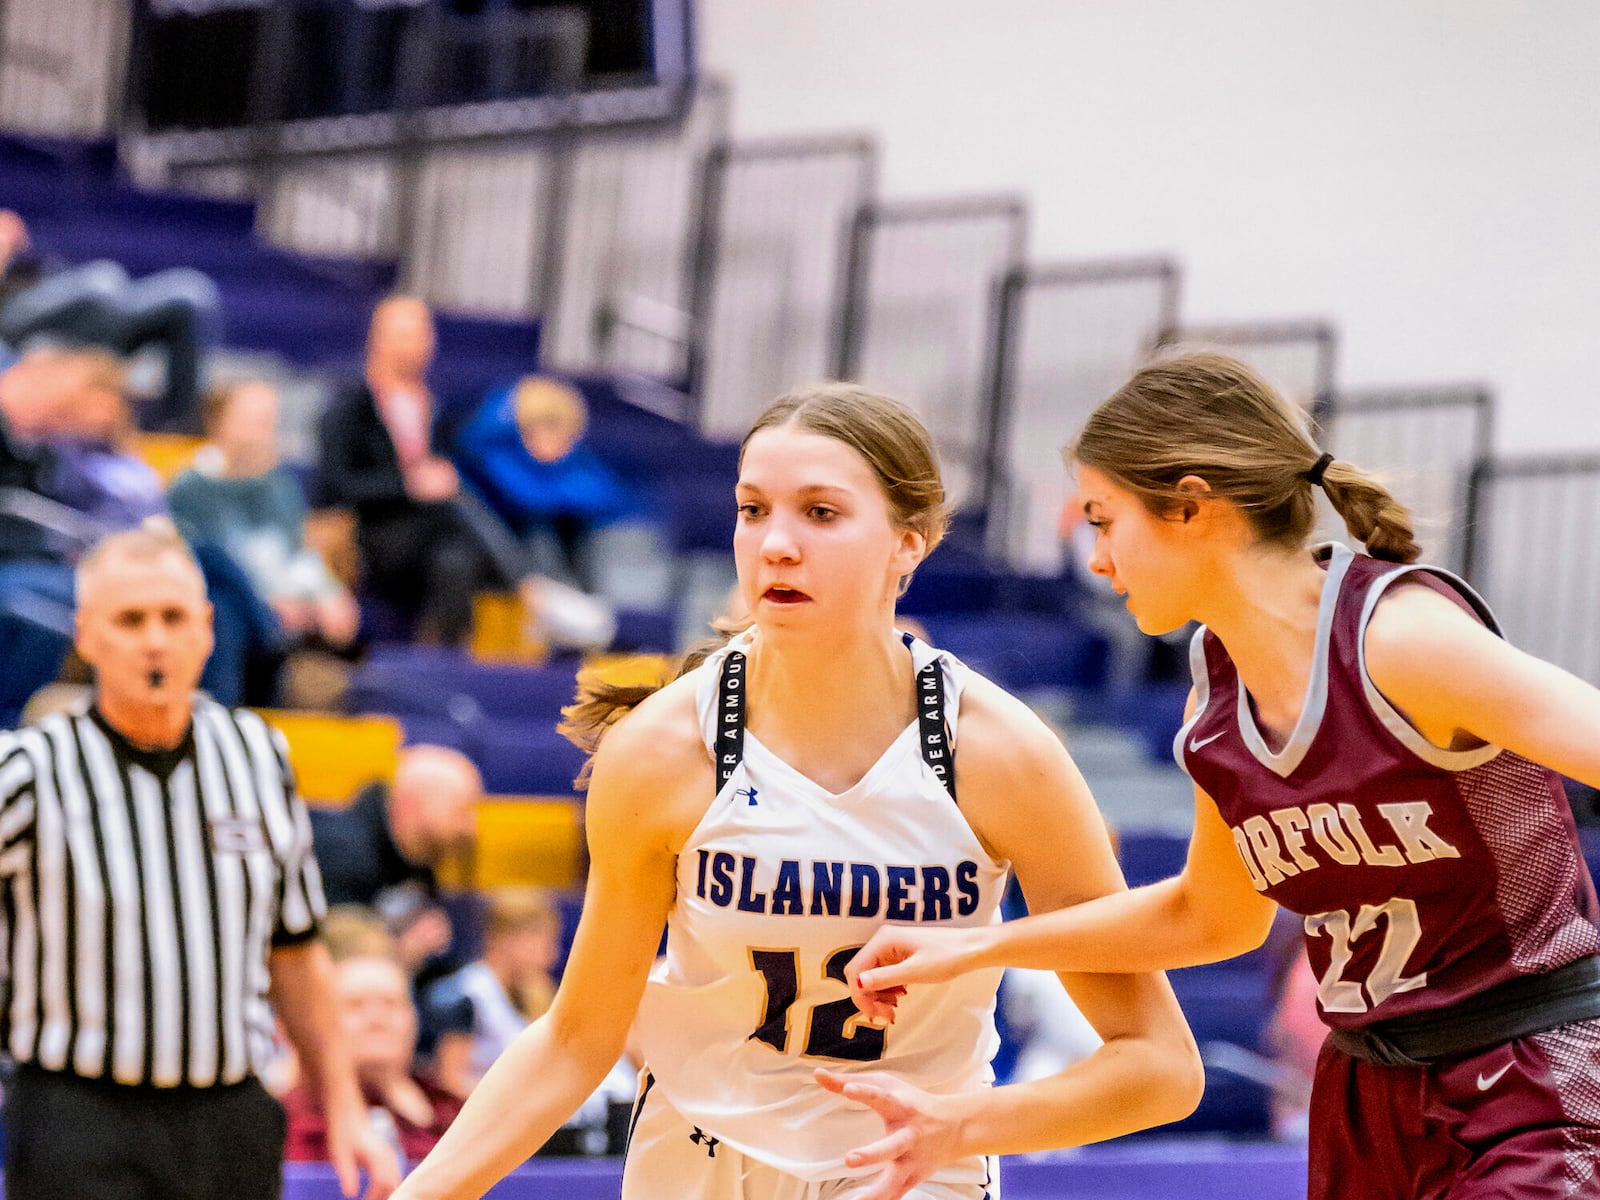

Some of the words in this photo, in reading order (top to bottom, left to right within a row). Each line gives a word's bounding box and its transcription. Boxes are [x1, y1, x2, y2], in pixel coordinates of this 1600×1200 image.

[696, 848, 981, 921] ISLANDERS
[745, 944, 889, 1065] 12
[1304, 896, 1428, 1014] 22
